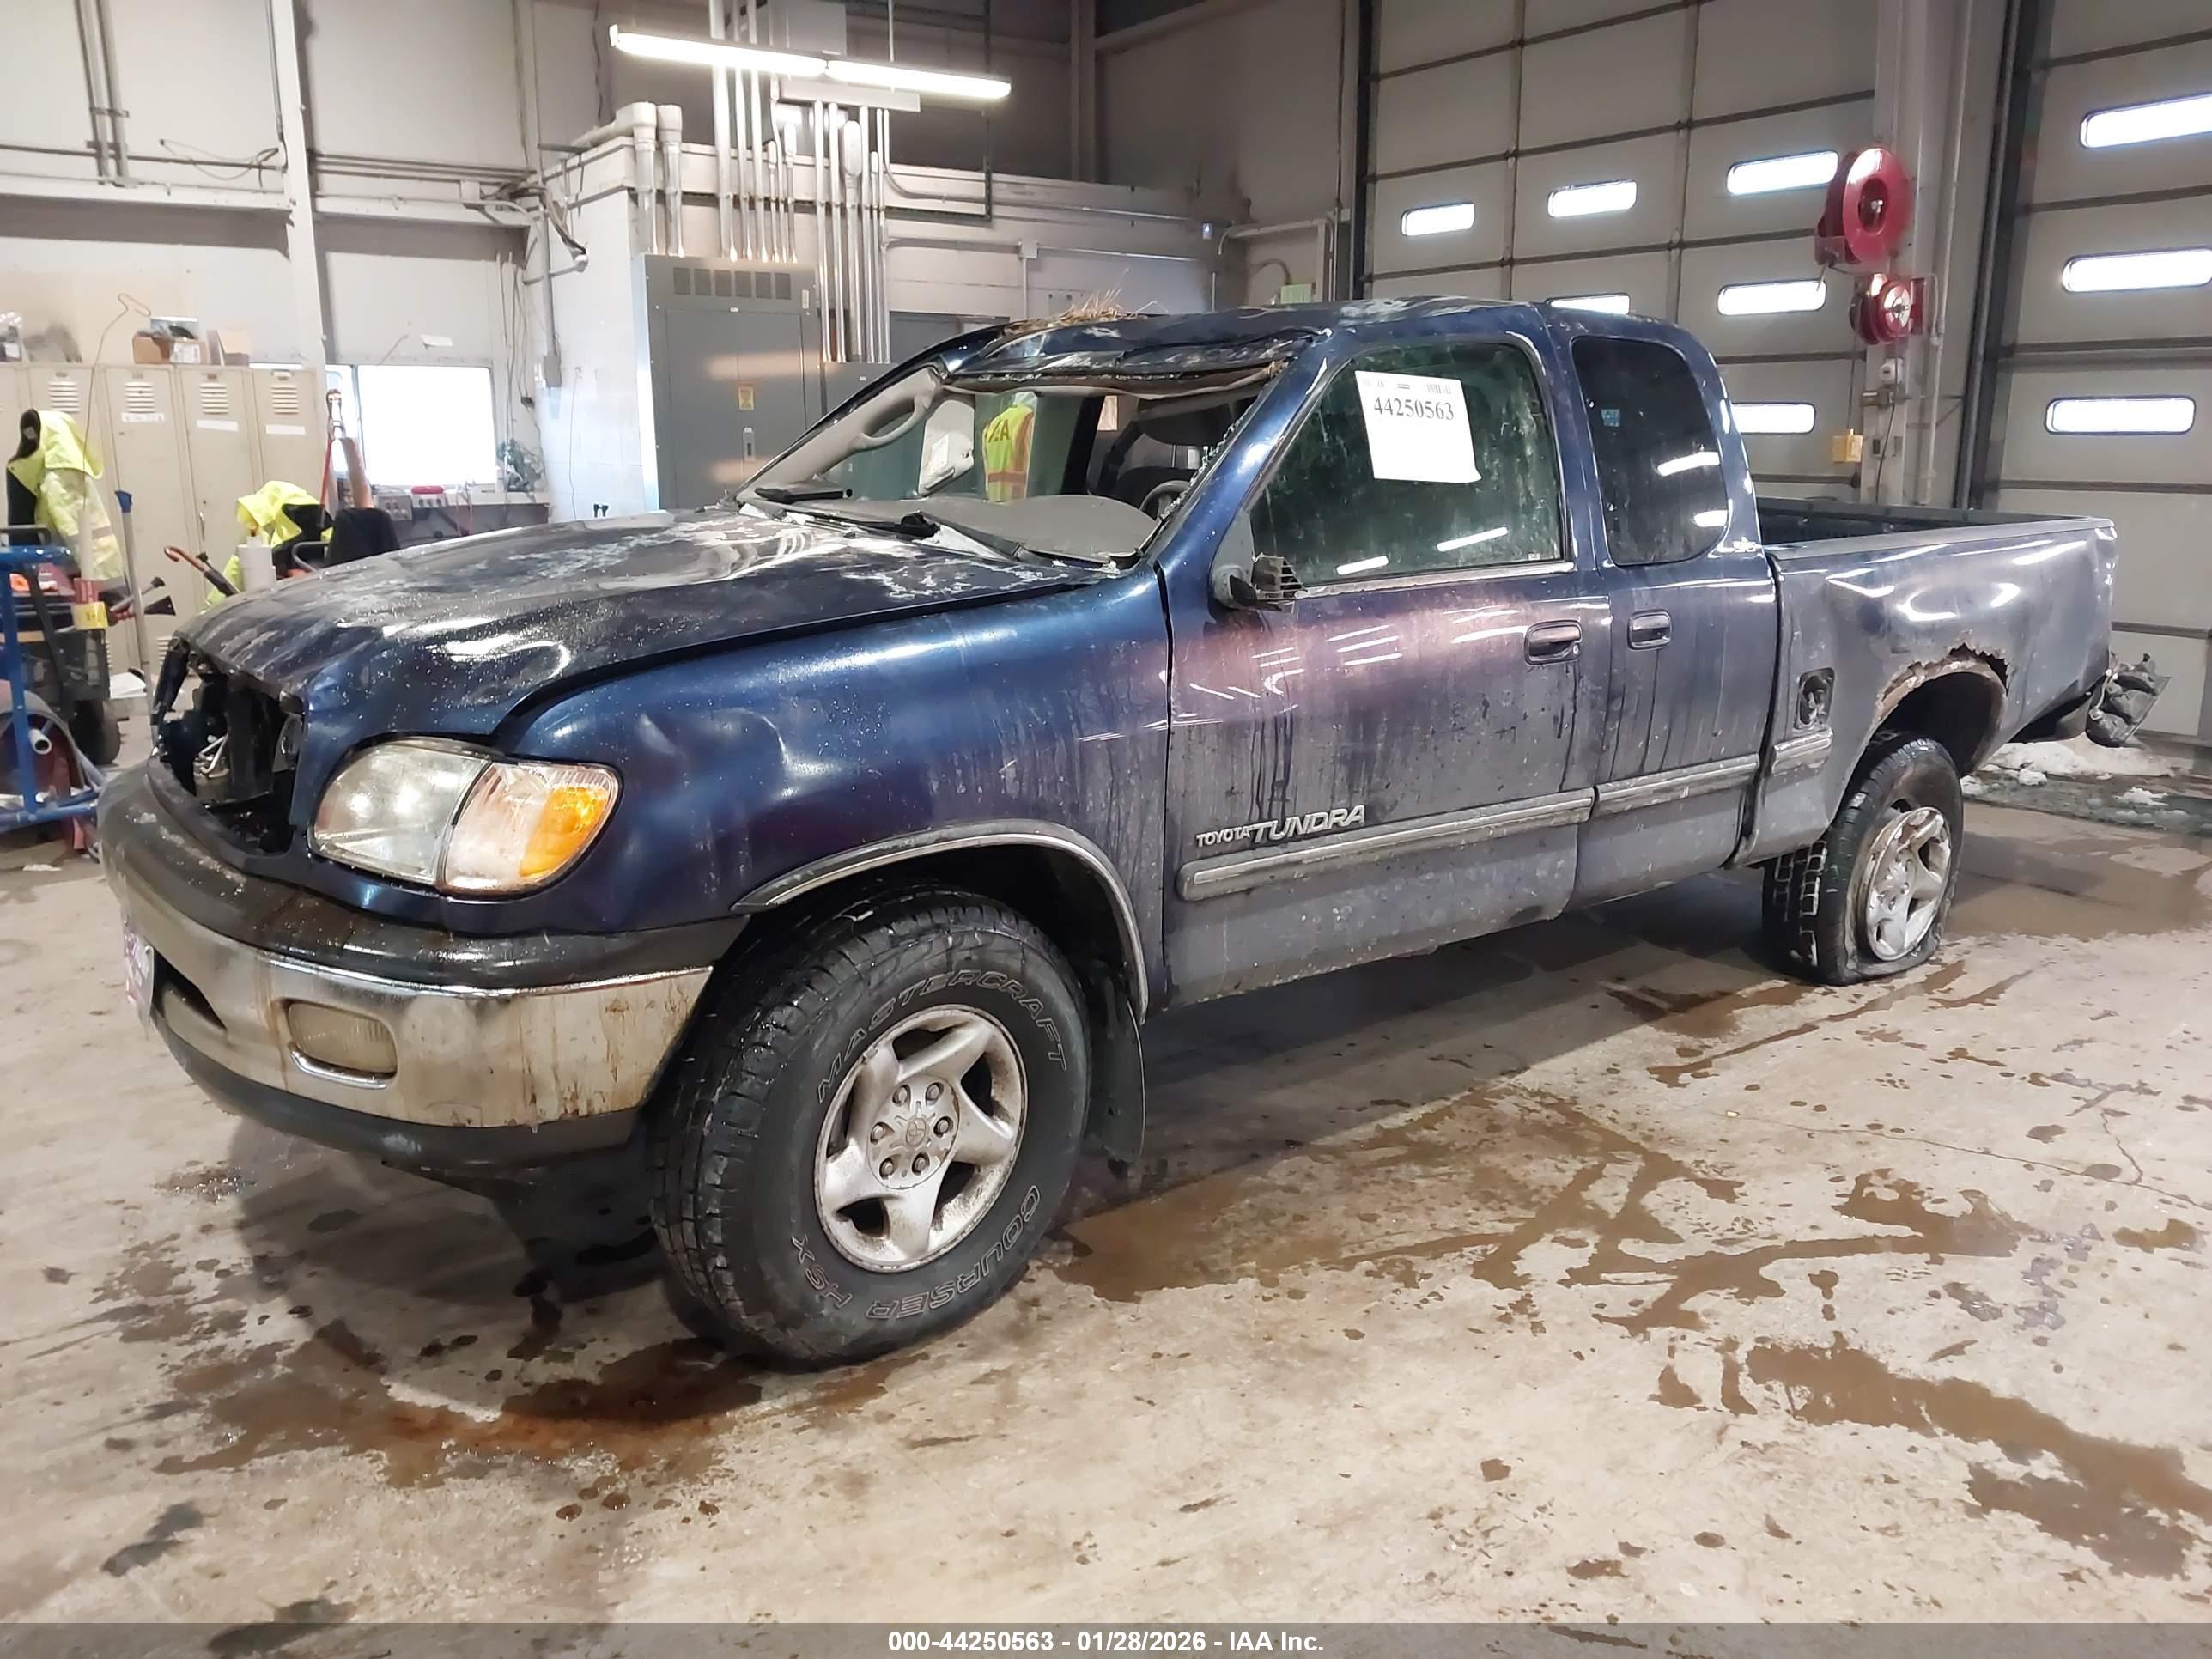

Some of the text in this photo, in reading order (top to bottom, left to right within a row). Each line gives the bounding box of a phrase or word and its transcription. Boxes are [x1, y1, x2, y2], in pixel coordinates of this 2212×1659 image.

[1374, 397, 1454, 421] 44250563
[1196, 805, 1364, 847] TOYOTA TUNDRA
[818, 969, 1066, 1103] MASTERCRAFT
[792, 1186, 1041, 1320] COURSER HSX
